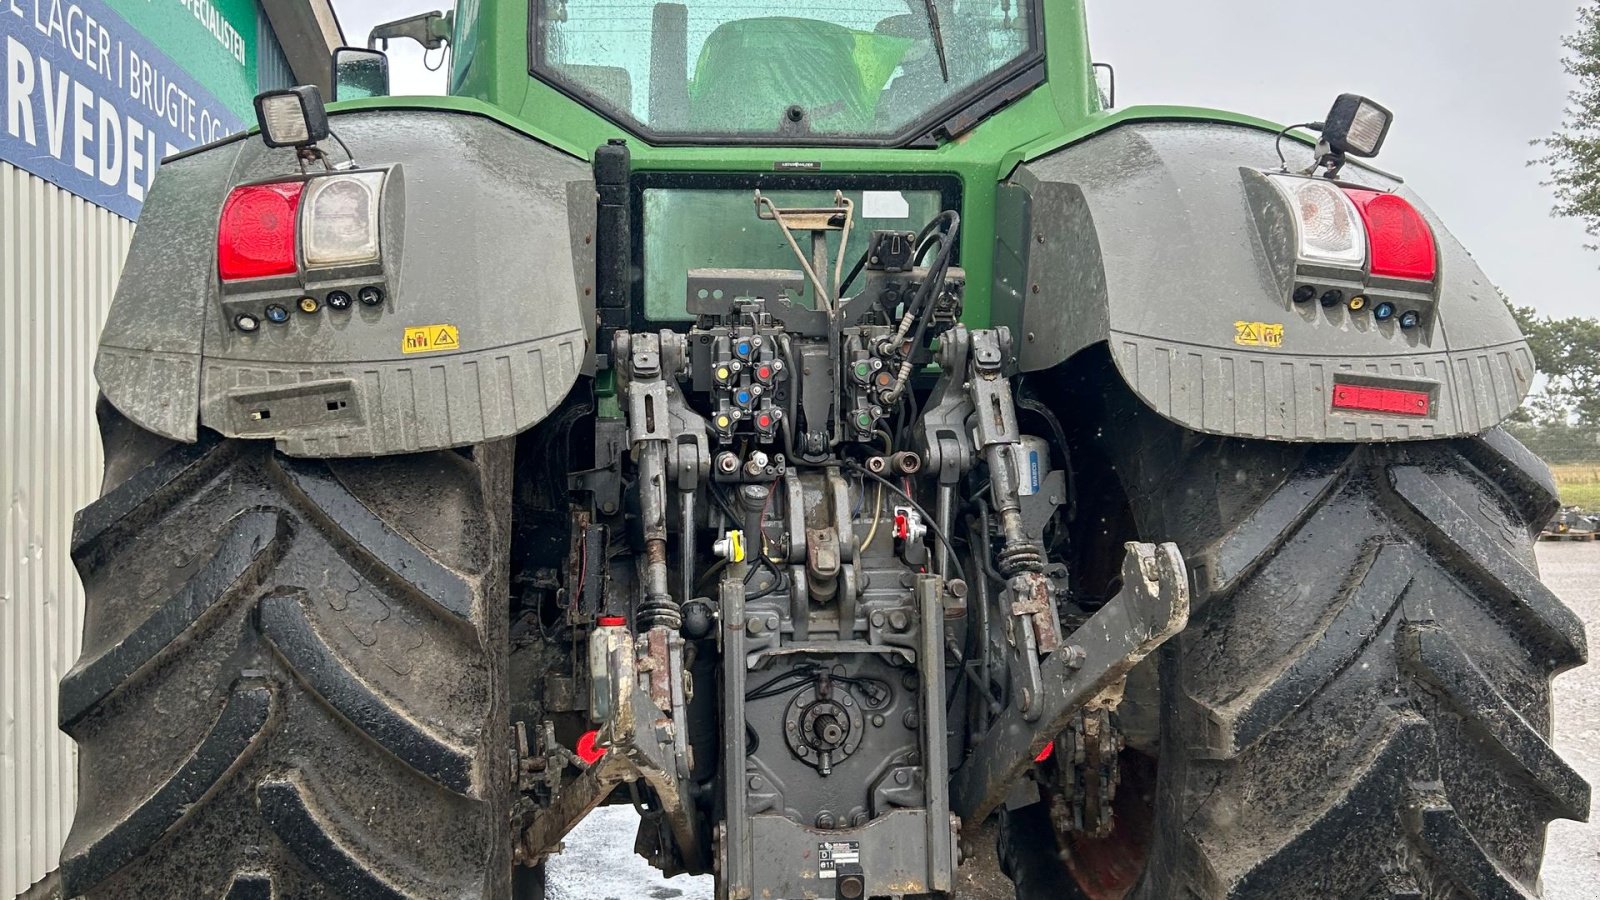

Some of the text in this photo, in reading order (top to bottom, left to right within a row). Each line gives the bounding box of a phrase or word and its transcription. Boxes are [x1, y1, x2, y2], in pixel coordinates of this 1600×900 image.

[7, 35, 180, 203] RVEDEL
[34, 0, 112, 81] LAGER
[118, 41, 123, 89] I
[130, 50, 196, 141] BRUGTE
